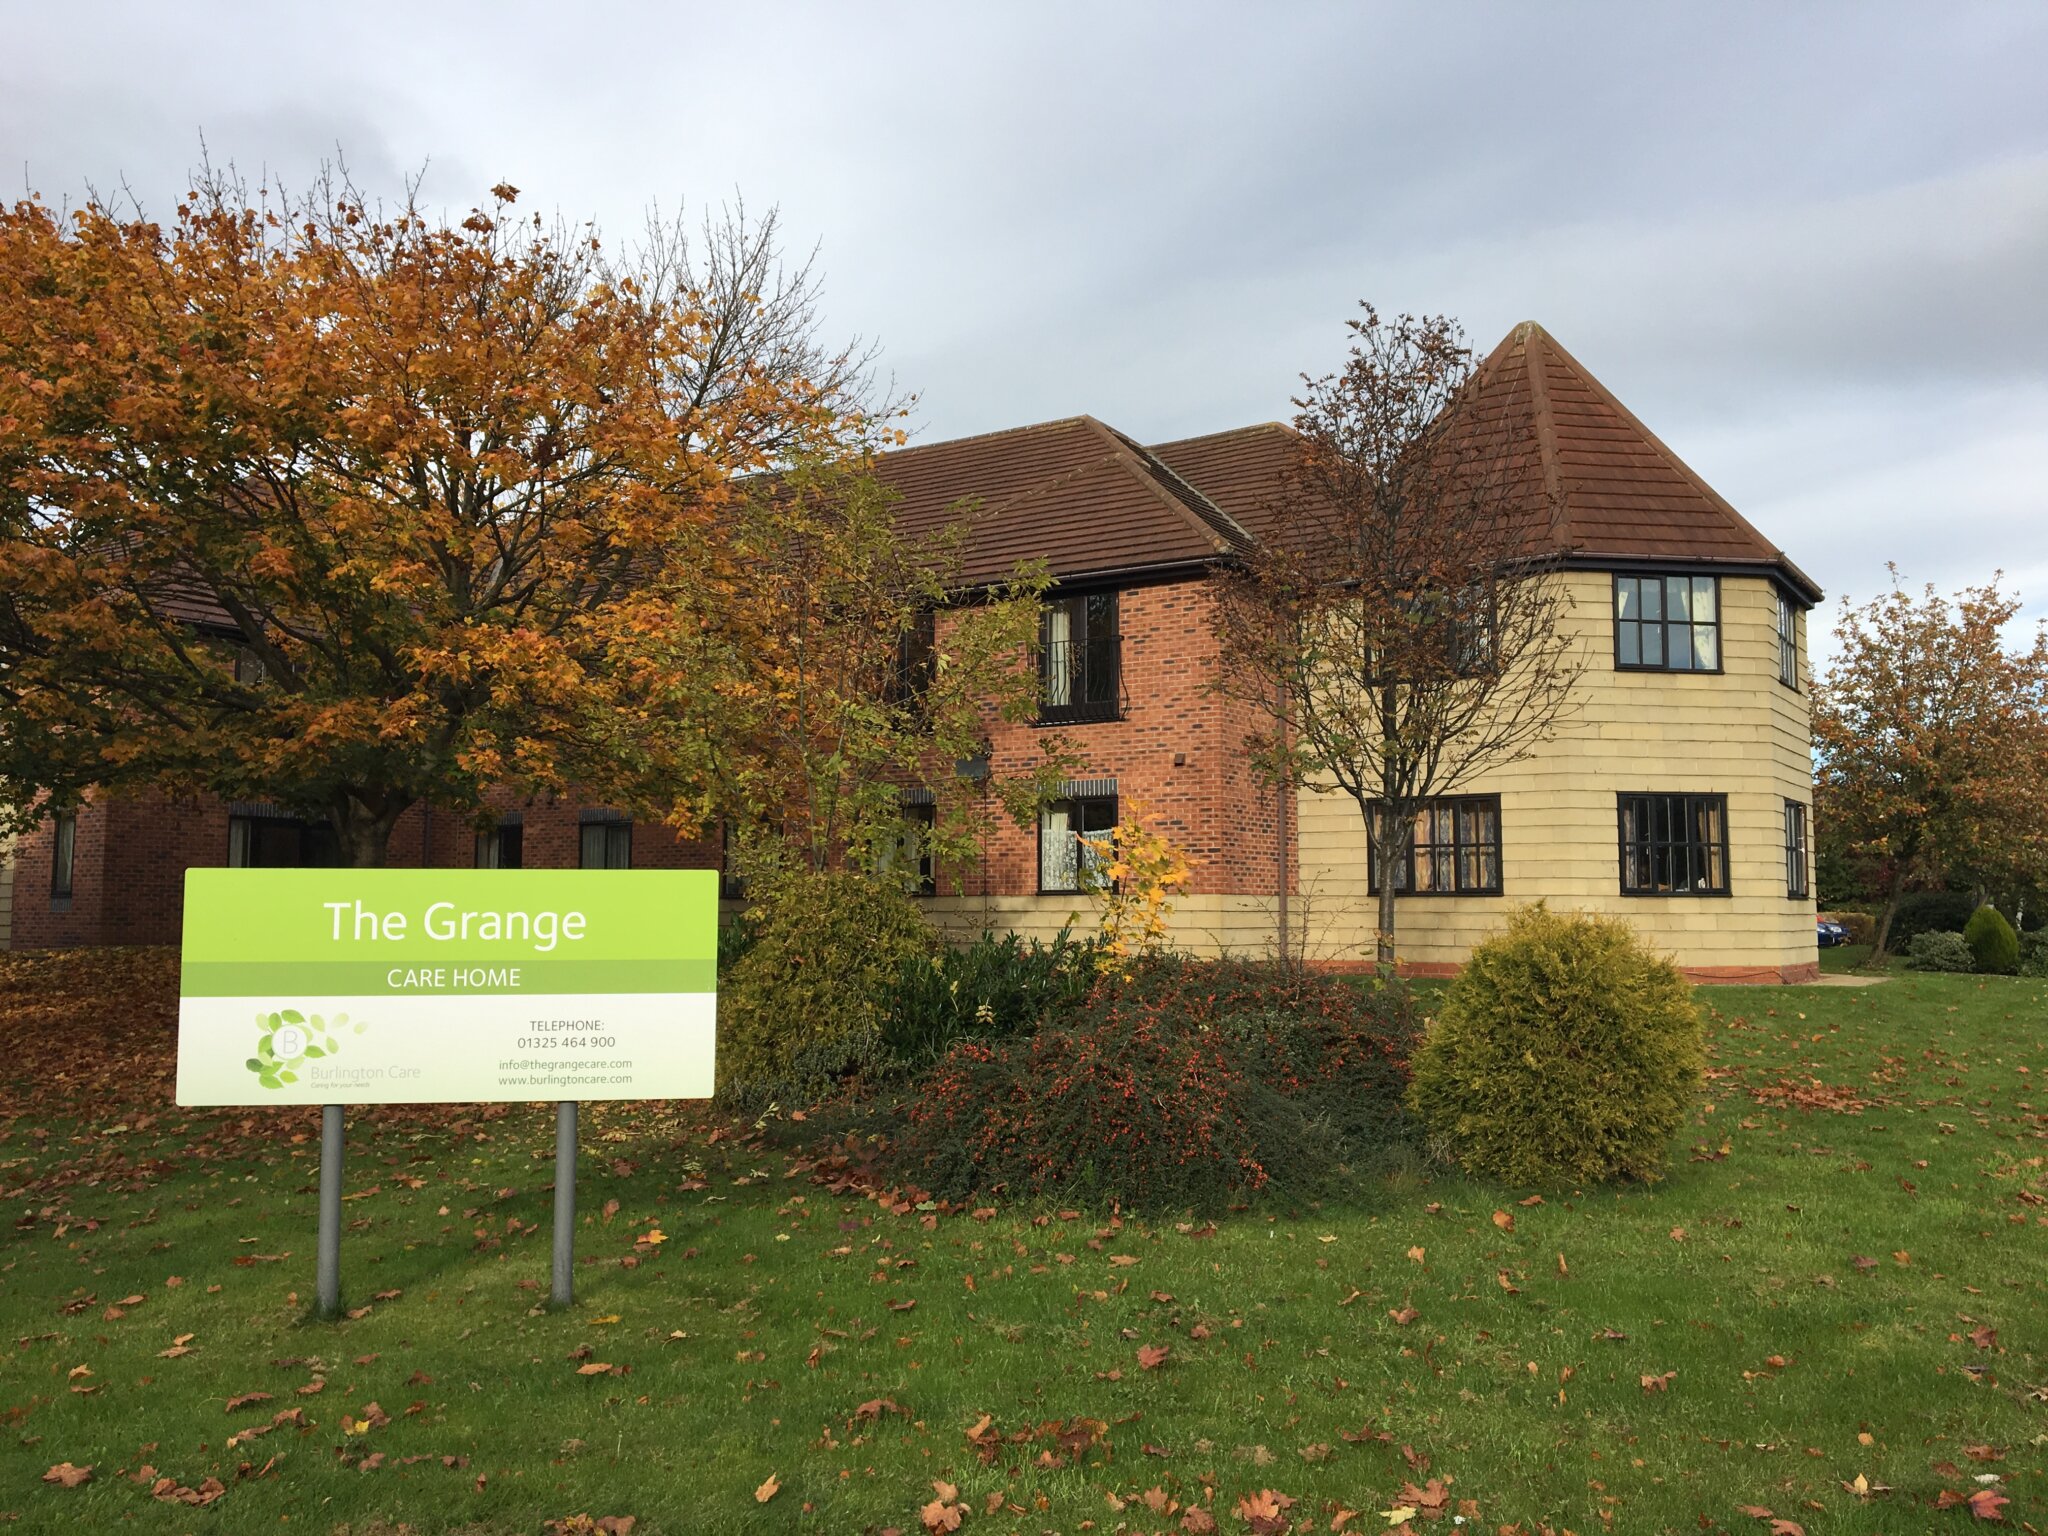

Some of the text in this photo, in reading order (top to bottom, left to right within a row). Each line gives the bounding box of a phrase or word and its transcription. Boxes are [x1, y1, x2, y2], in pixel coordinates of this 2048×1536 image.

[323, 899, 588, 951] The Grange
[386, 967, 522, 988] CARE HOME
[530, 1020, 605, 1031] TELEPHONE:
[283, 1030, 298, 1054] B
[517, 1036, 616, 1048] 01325 464 900
[499, 1058, 633, 1072] info@thegrangecare.com
[311, 1065, 421, 1081] Burlington Care
[498, 1074, 633, 1087] www.burlingtoncare.com
